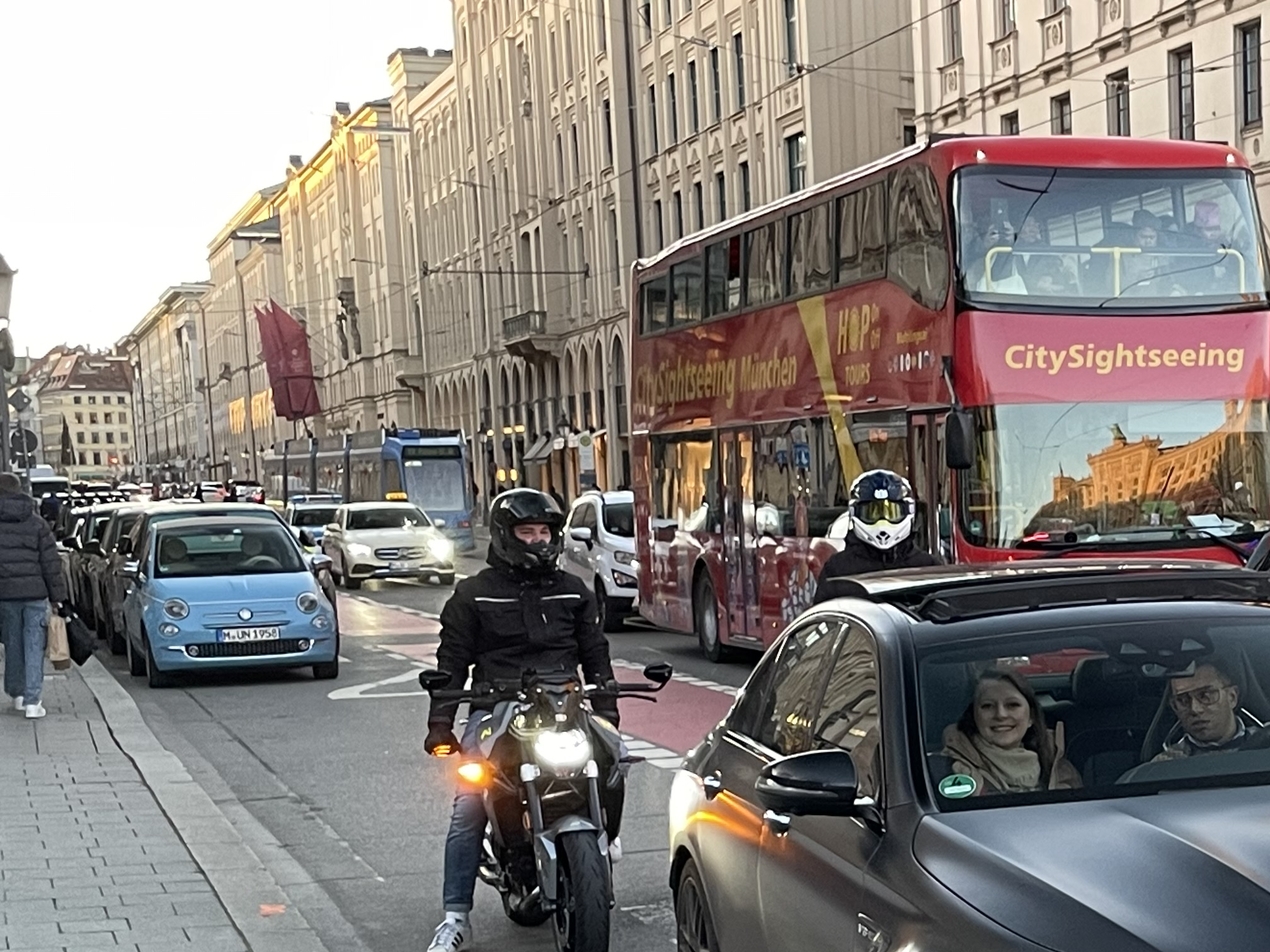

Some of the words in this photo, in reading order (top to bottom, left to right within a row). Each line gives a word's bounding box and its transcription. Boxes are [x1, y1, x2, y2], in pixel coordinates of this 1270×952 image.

[636, 354, 736, 416] CitySightseeing
[740, 346, 798, 392] München
[1004, 342, 1245, 375] CitySightseeing
